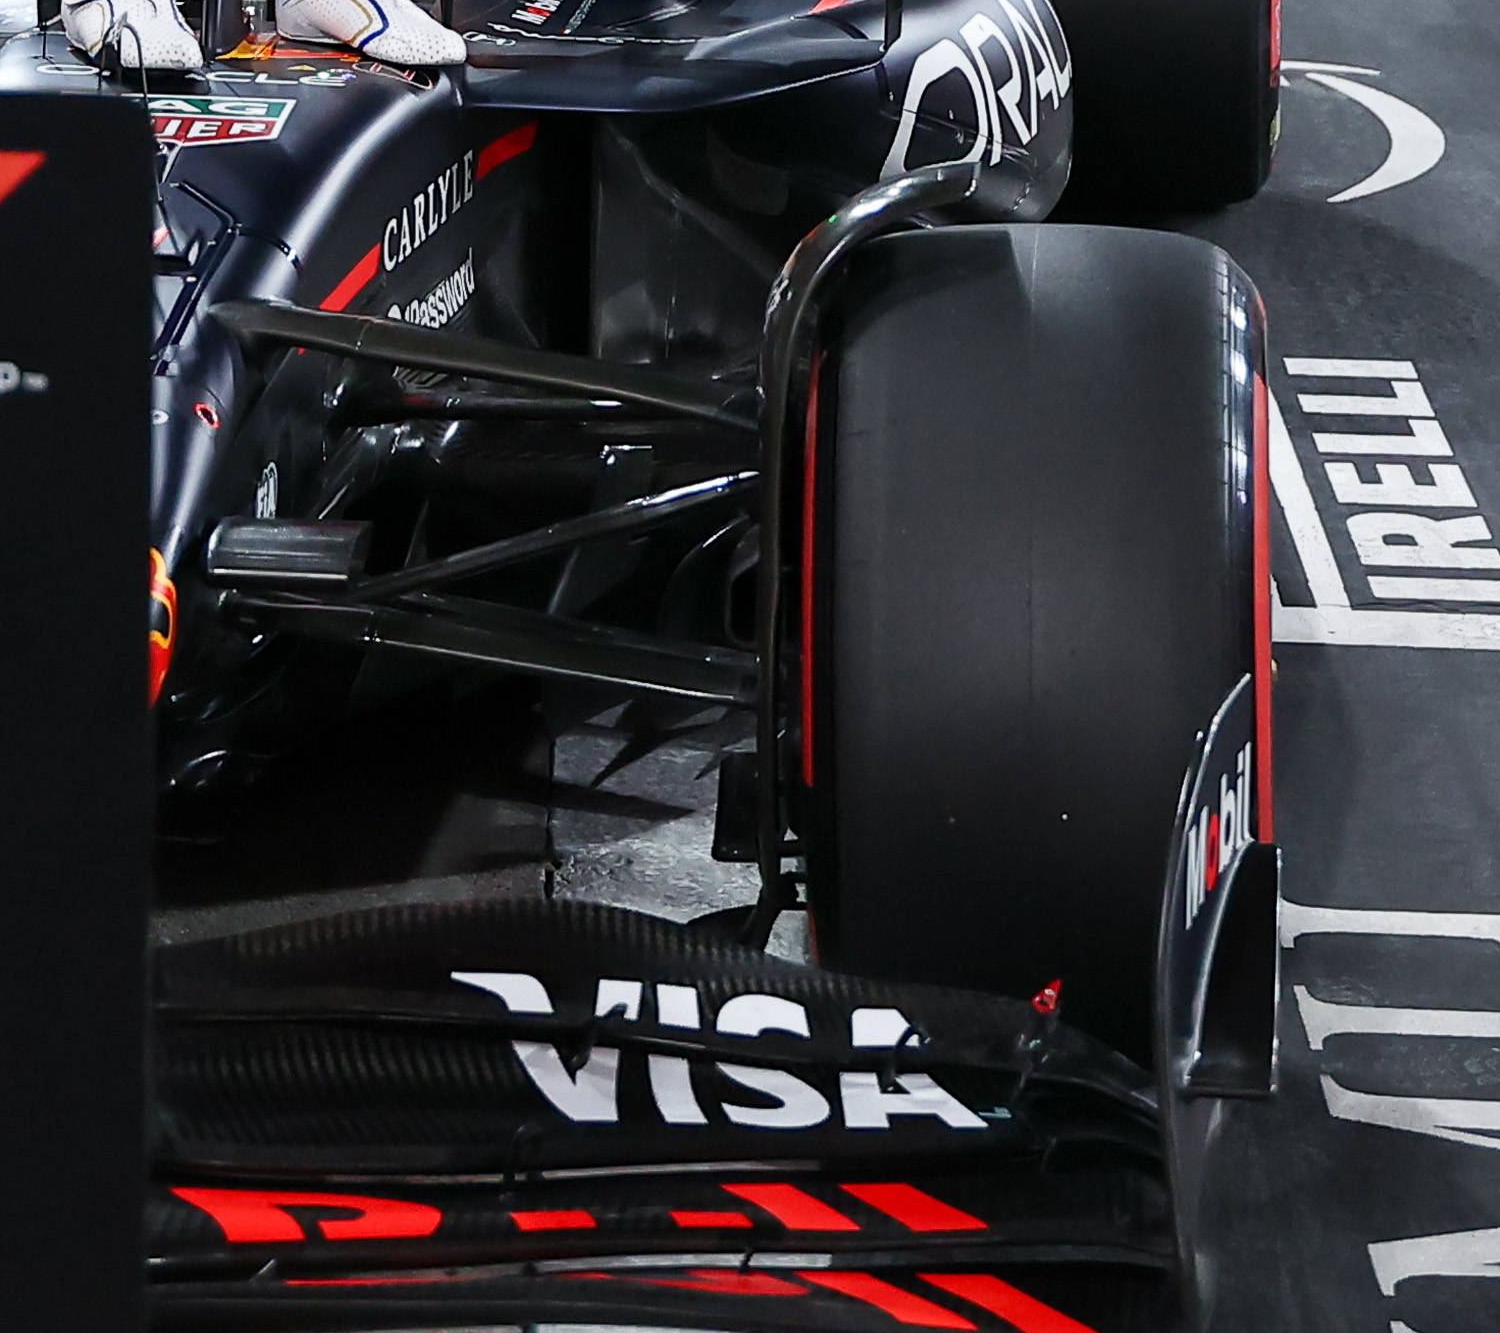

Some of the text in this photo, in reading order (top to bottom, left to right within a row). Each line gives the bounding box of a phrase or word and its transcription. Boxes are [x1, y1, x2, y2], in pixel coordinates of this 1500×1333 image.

[36, 62, 347, 88] OCLE
[148, 98, 270, 117] AG
[381, 149, 476, 273] CARLYLE
[1185, 739, 1255, 932] Mobil
[448, 969, 993, 1131] VISA
